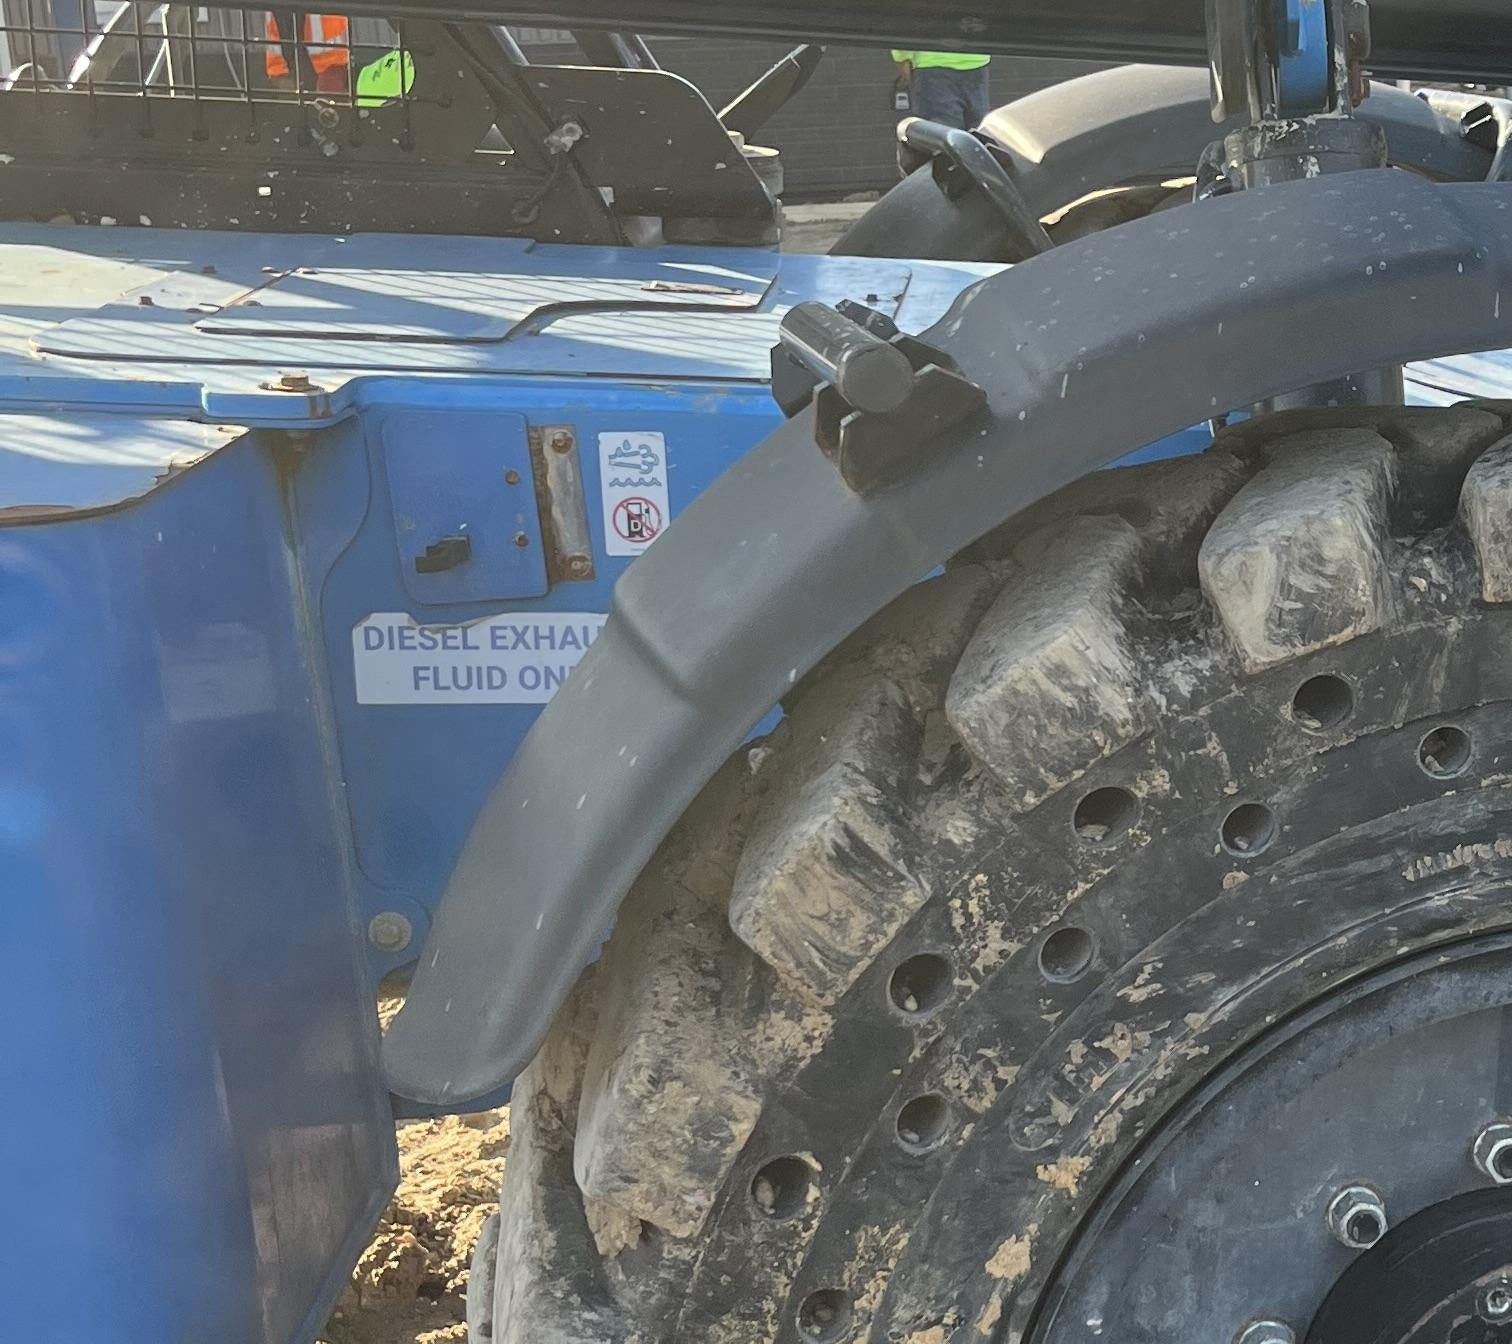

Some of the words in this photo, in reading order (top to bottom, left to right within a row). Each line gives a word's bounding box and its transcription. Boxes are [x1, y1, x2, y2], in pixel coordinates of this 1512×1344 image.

[363, 625, 480, 651] DIESEL
[412, 665, 508, 691] FLUID
[518, 665, 576, 691] ON
